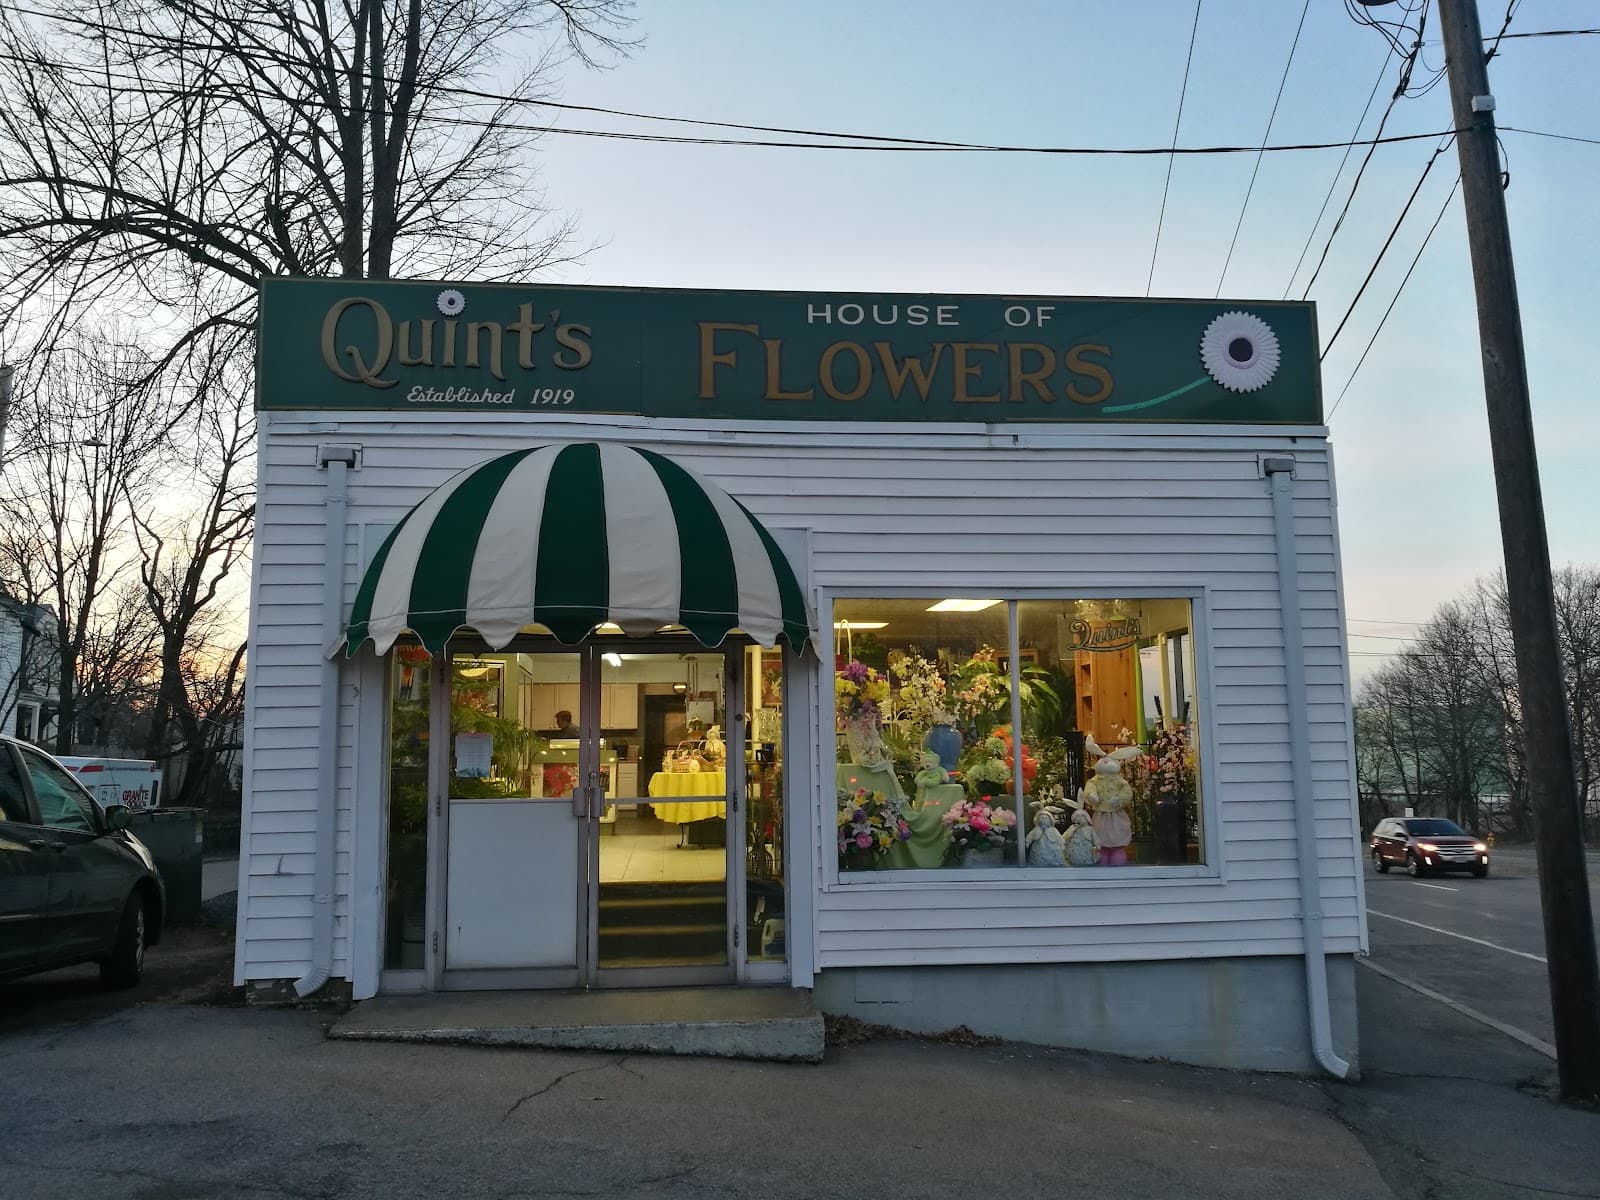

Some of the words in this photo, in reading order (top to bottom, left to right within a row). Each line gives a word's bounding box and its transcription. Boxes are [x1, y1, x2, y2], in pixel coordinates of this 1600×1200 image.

[321, 294, 592, 388] Quint's
[806, 303, 960, 326] HOUSE
[1004, 305, 1056, 328] OF
[696, 321, 1115, 404] FLOWERS
[406, 385, 516, 405] Established
[529, 388, 577, 406] 1919
